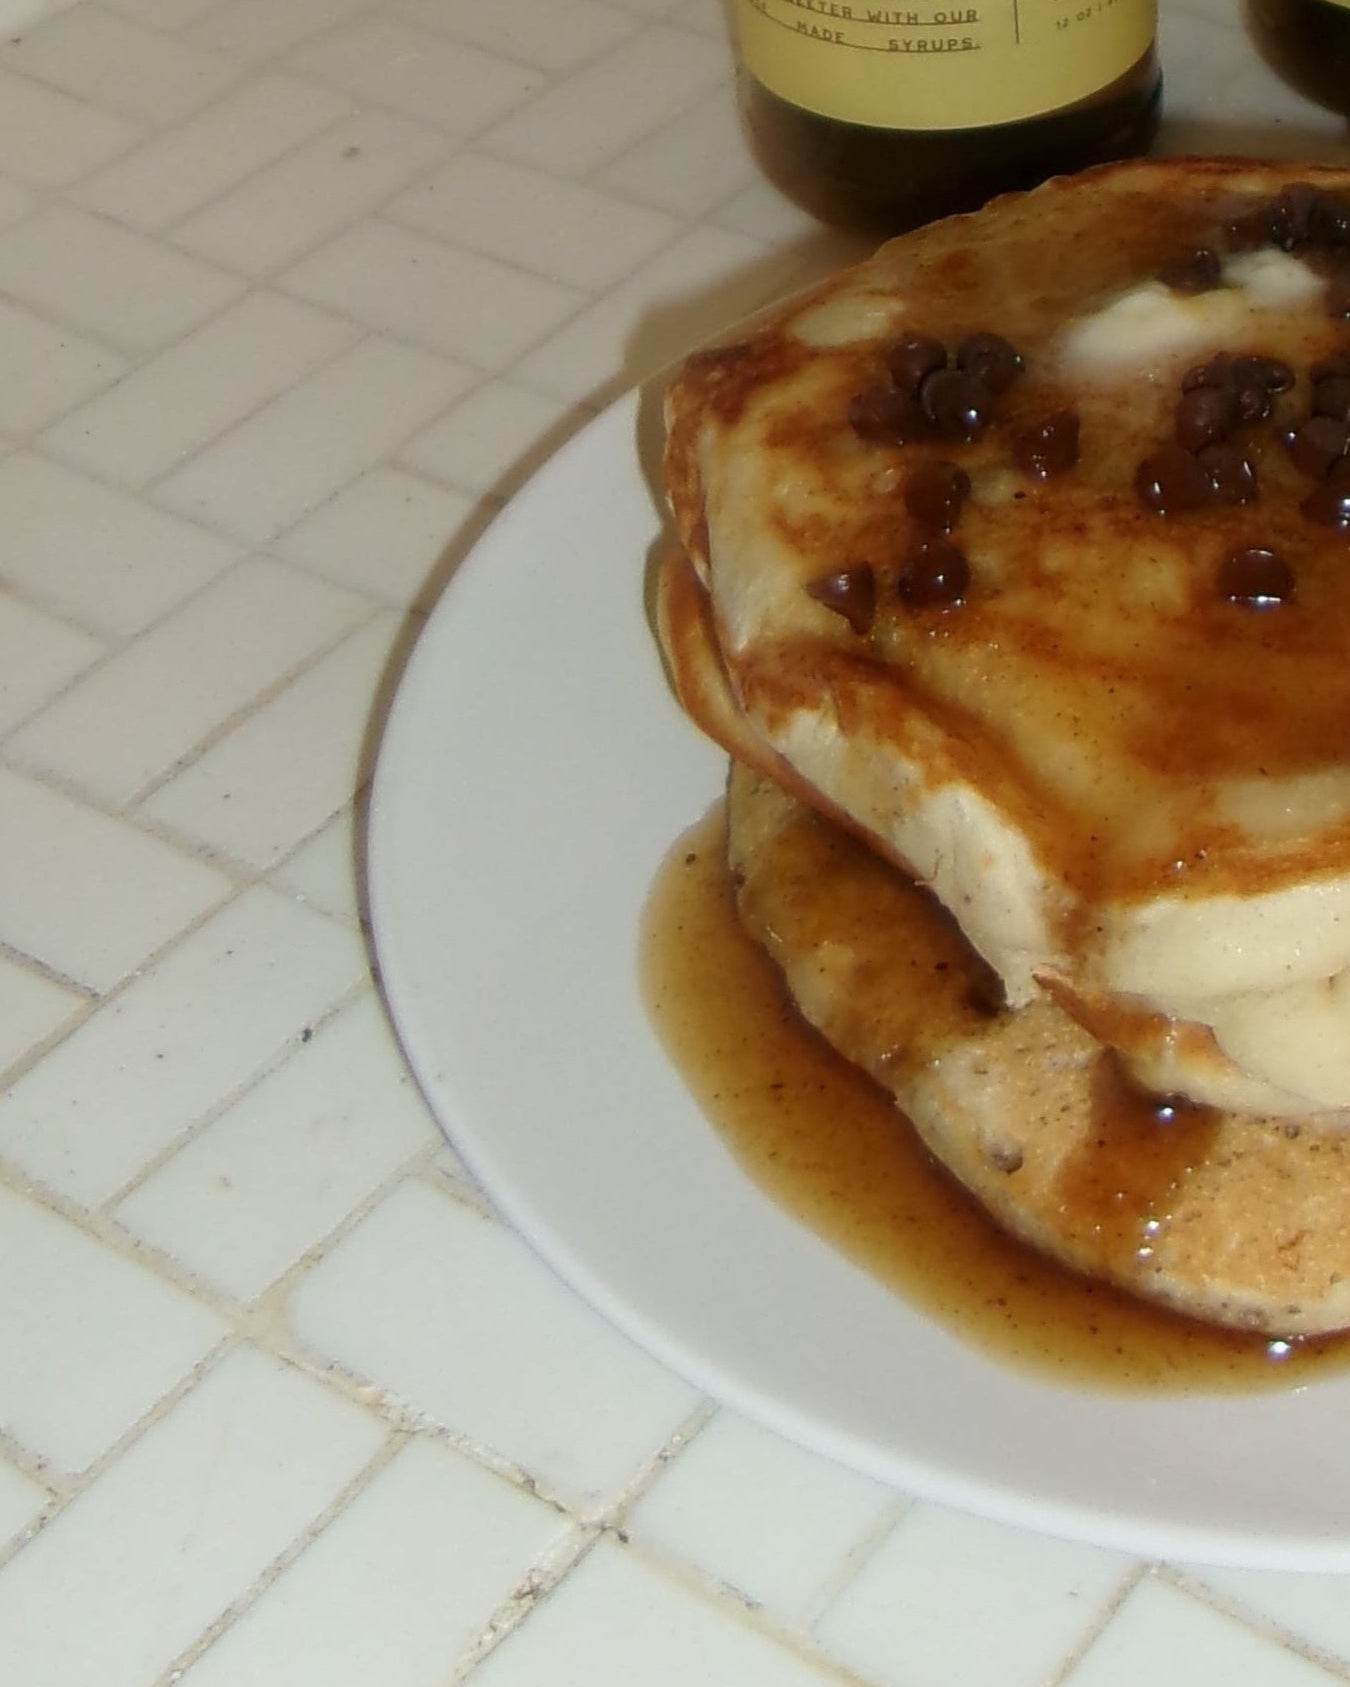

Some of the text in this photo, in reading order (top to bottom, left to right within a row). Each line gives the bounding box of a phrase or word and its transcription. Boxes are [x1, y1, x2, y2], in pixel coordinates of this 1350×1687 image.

[867, 9, 919, 25] WITH
[934, 9, 978, 23] OUR
[797, 20, 845, 44] MADE
